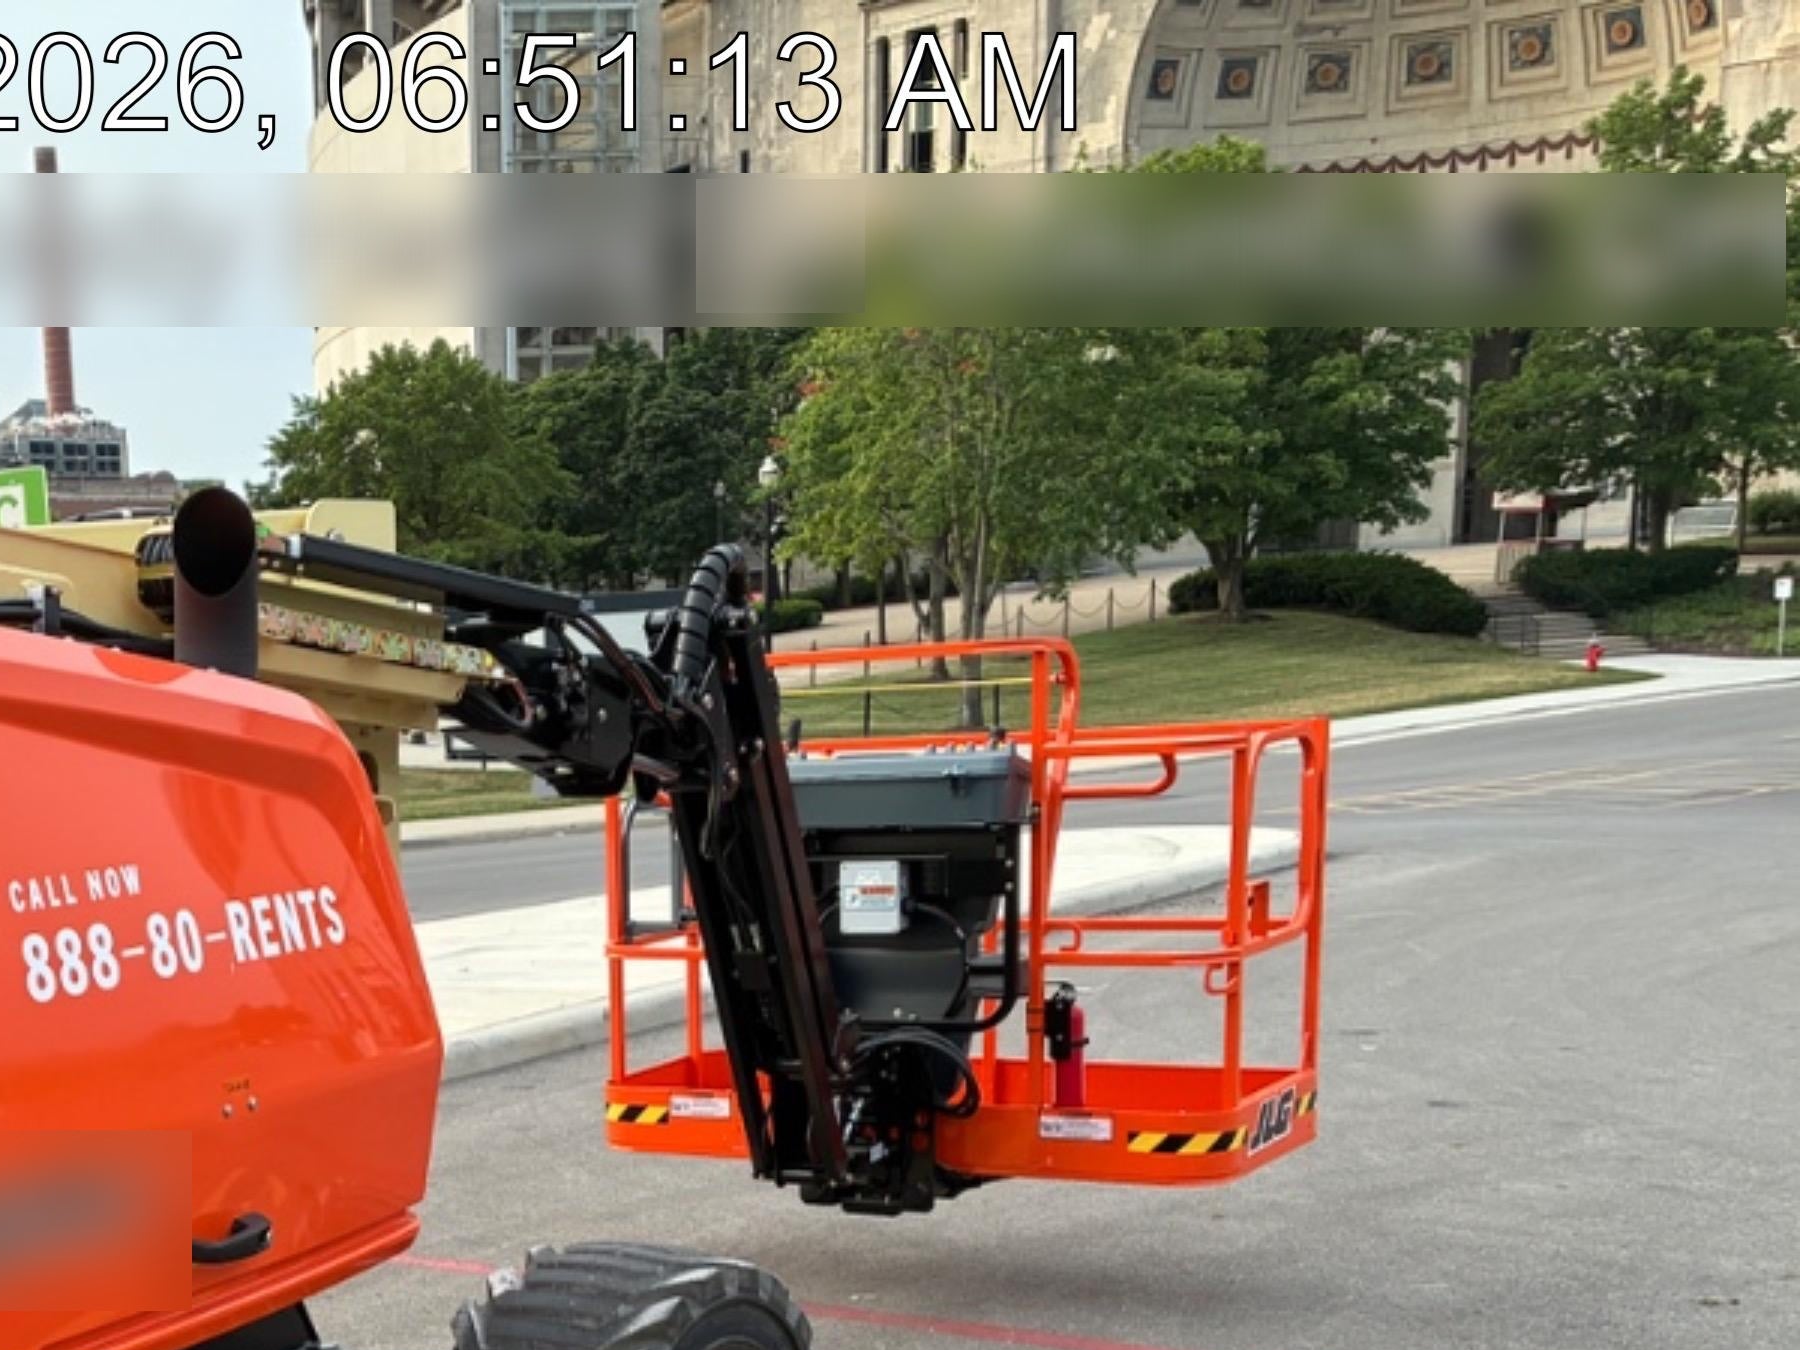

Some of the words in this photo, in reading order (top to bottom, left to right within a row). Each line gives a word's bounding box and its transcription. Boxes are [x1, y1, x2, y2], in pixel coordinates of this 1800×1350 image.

[8, 873, 79, 913] CALL
[85, 863, 142, 901] NOW
[21, 885, 347, 1003] 888-80-RENTS
